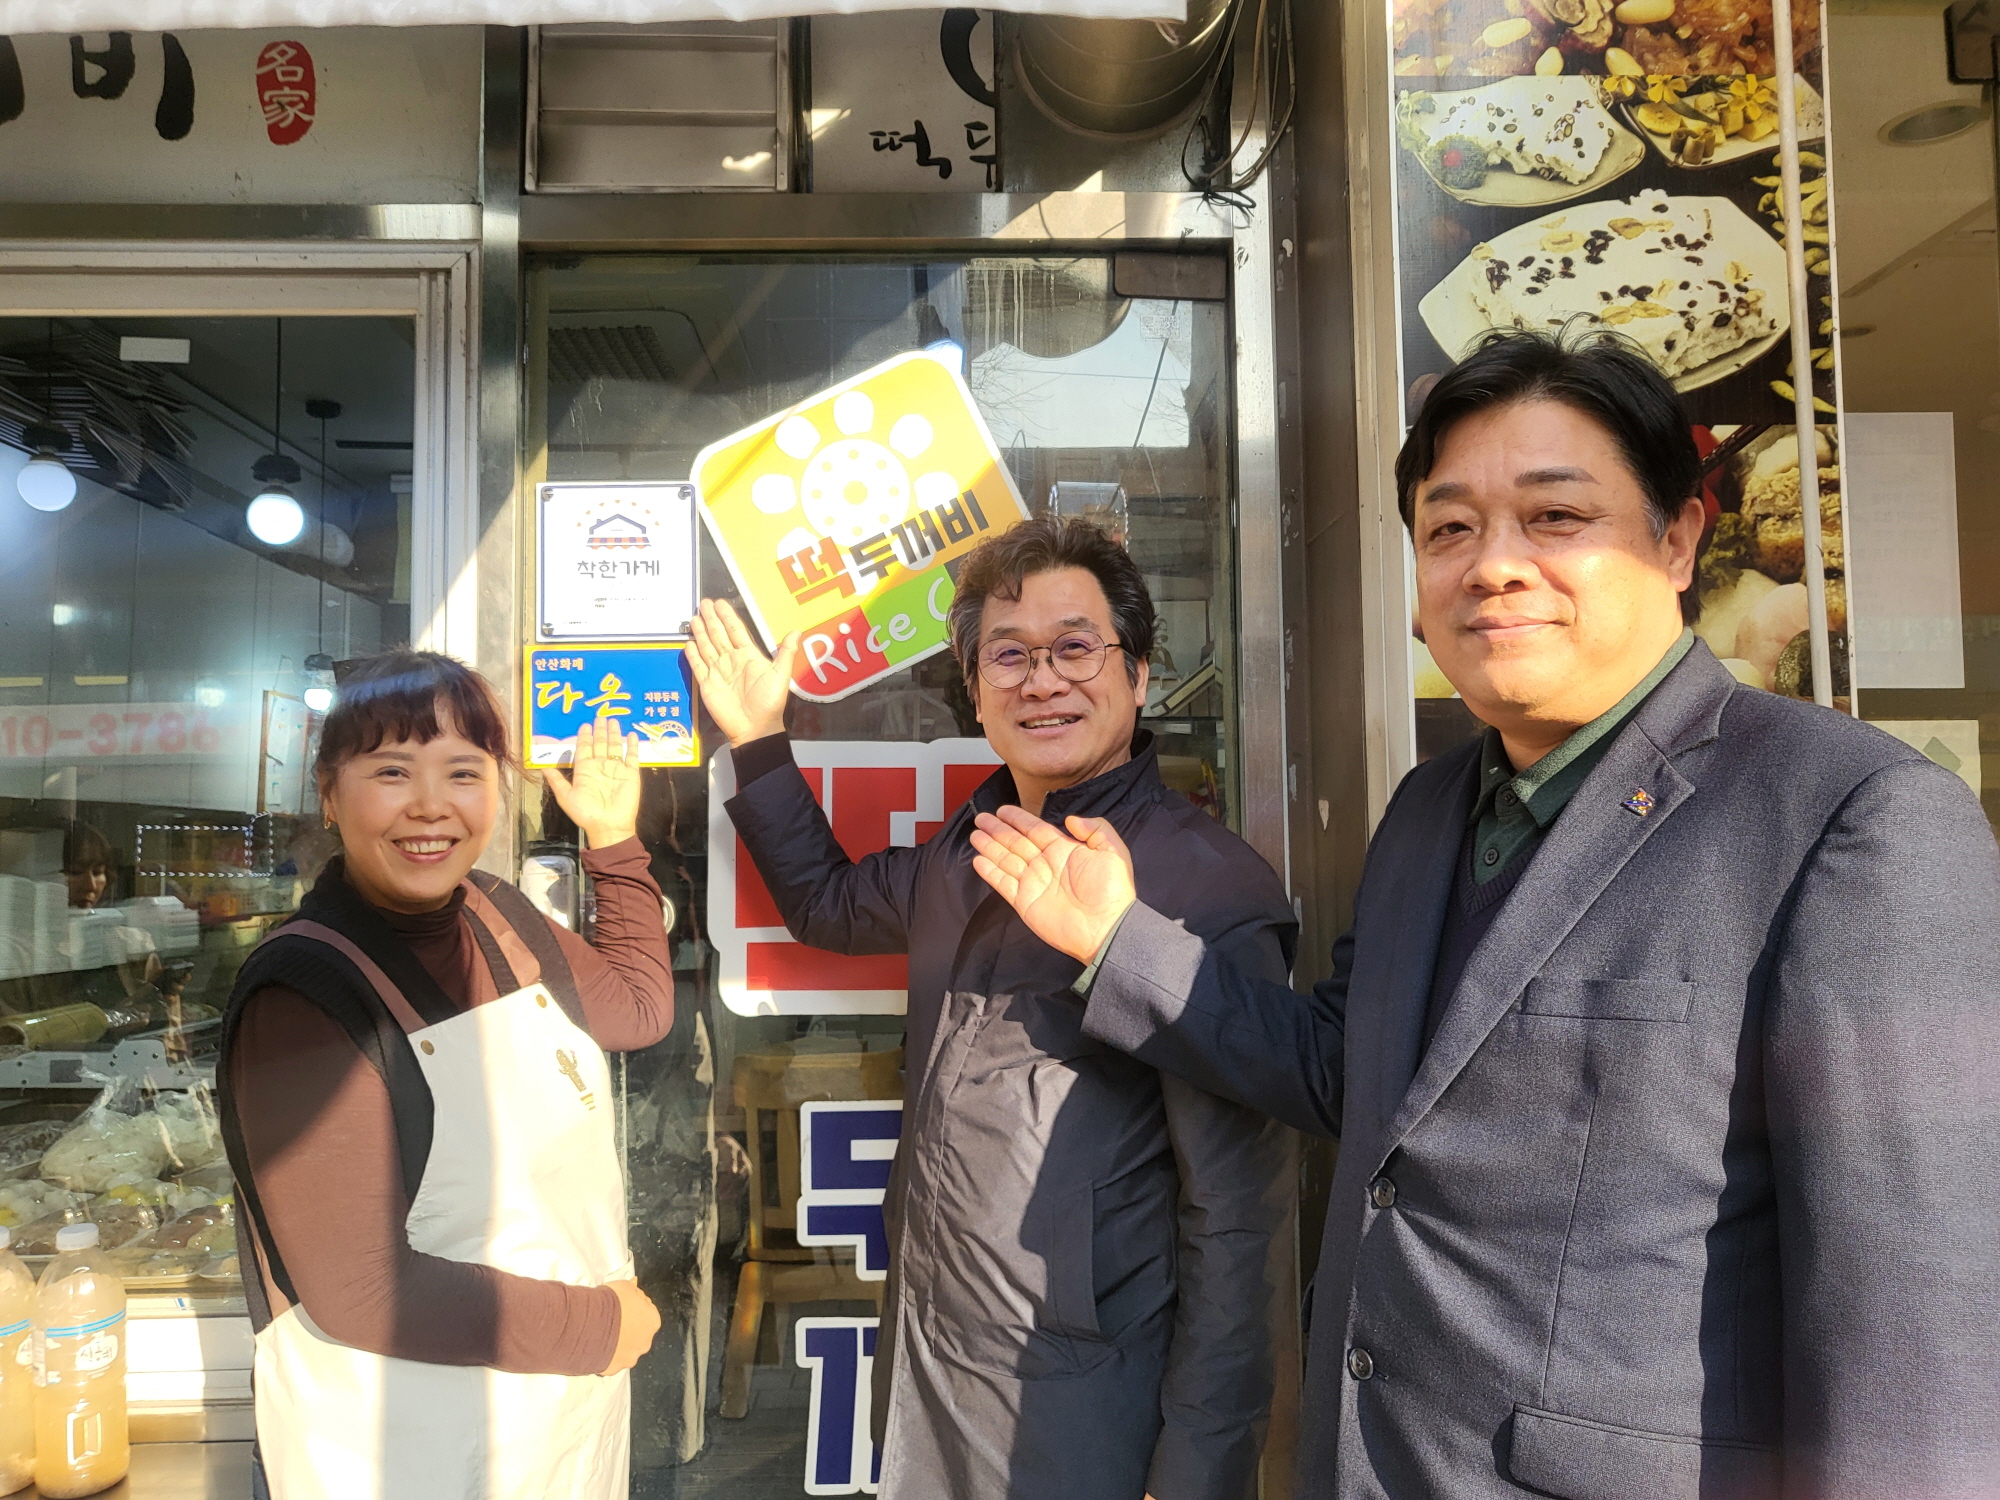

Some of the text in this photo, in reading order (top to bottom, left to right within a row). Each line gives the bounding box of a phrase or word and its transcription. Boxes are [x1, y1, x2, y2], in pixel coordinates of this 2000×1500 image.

[256, 43, 315, 129] 名家
[577, 560, 661, 579] 착한가게
[775, 489, 990, 606] 떡두꺼비
[534, 657, 584, 671] 안산화폐
[802, 576, 948, 684] Rice C
